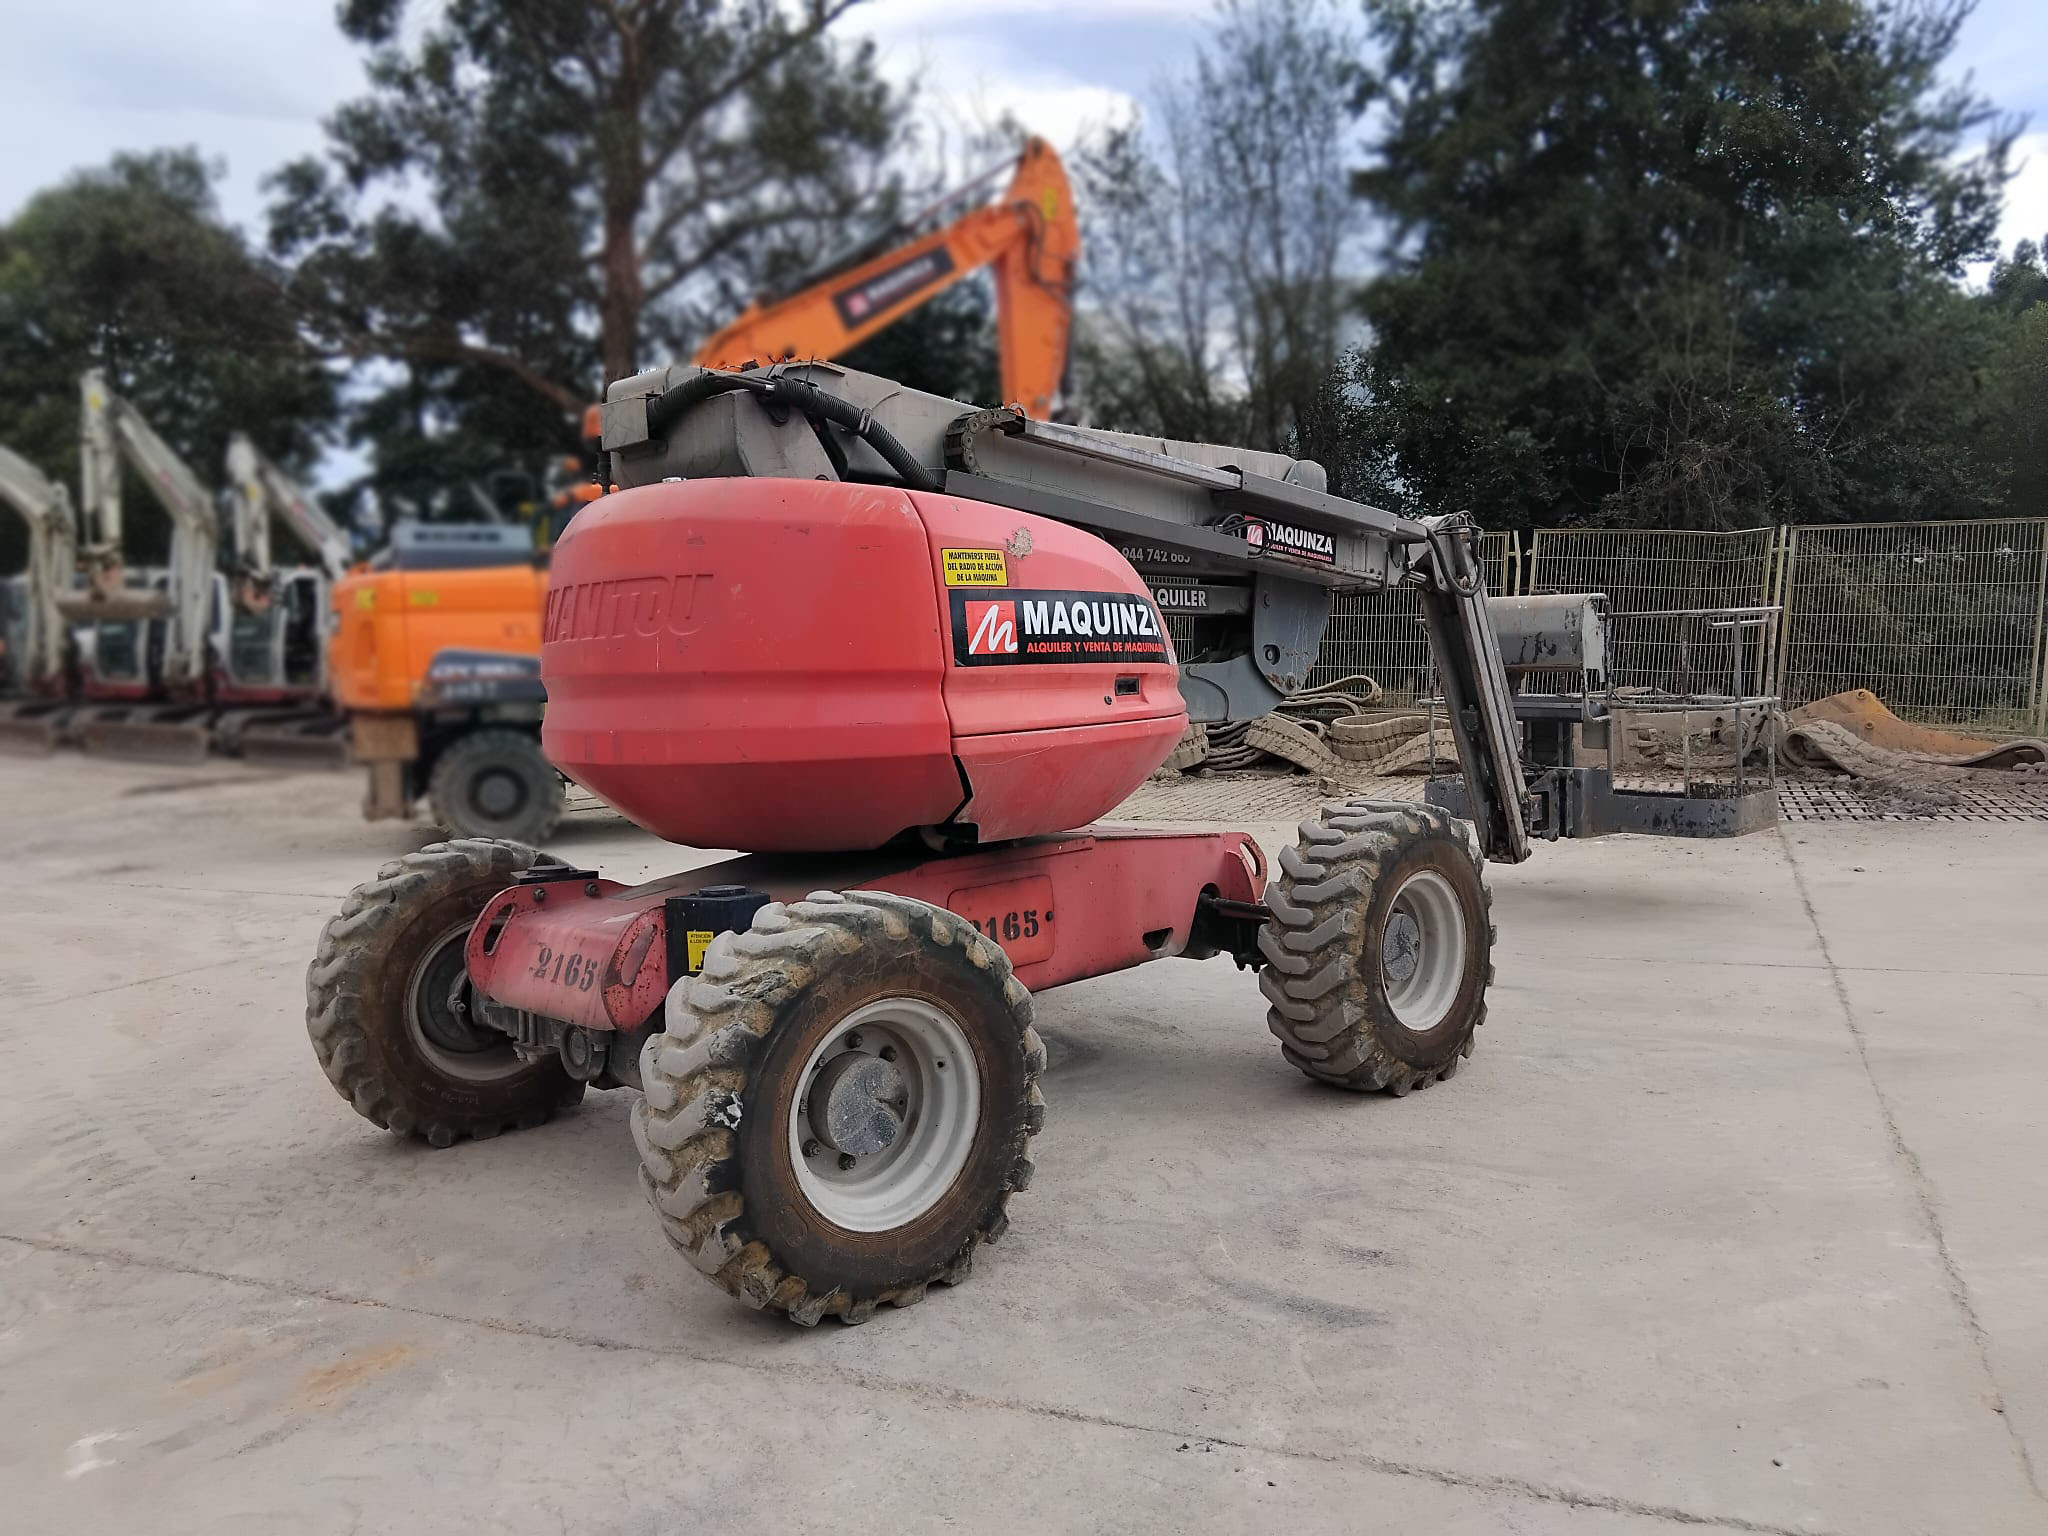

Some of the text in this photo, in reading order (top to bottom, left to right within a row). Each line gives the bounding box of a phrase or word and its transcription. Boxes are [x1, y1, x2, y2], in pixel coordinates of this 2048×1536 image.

[948, 552, 984, 560] MANTENERSE
[1122, 546, 1144, 561] 944
[1146, 548, 1168, 562] 742
[959, 563, 976, 571] RADIO
[977, 563, 984, 571] DE
[956, 573, 964, 581] DE
[965, 573, 972, 582] LA
[1022, 600, 1162, 638] MAQUINZA
[1026, 641, 1073, 653] ALQUILER
[1074, 641, 1081, 653] Y
[1082, 641, 1111, 653] VENTA
[1112, 642, 1123, 652] DE
[533, 947, 598, 993] 2165
